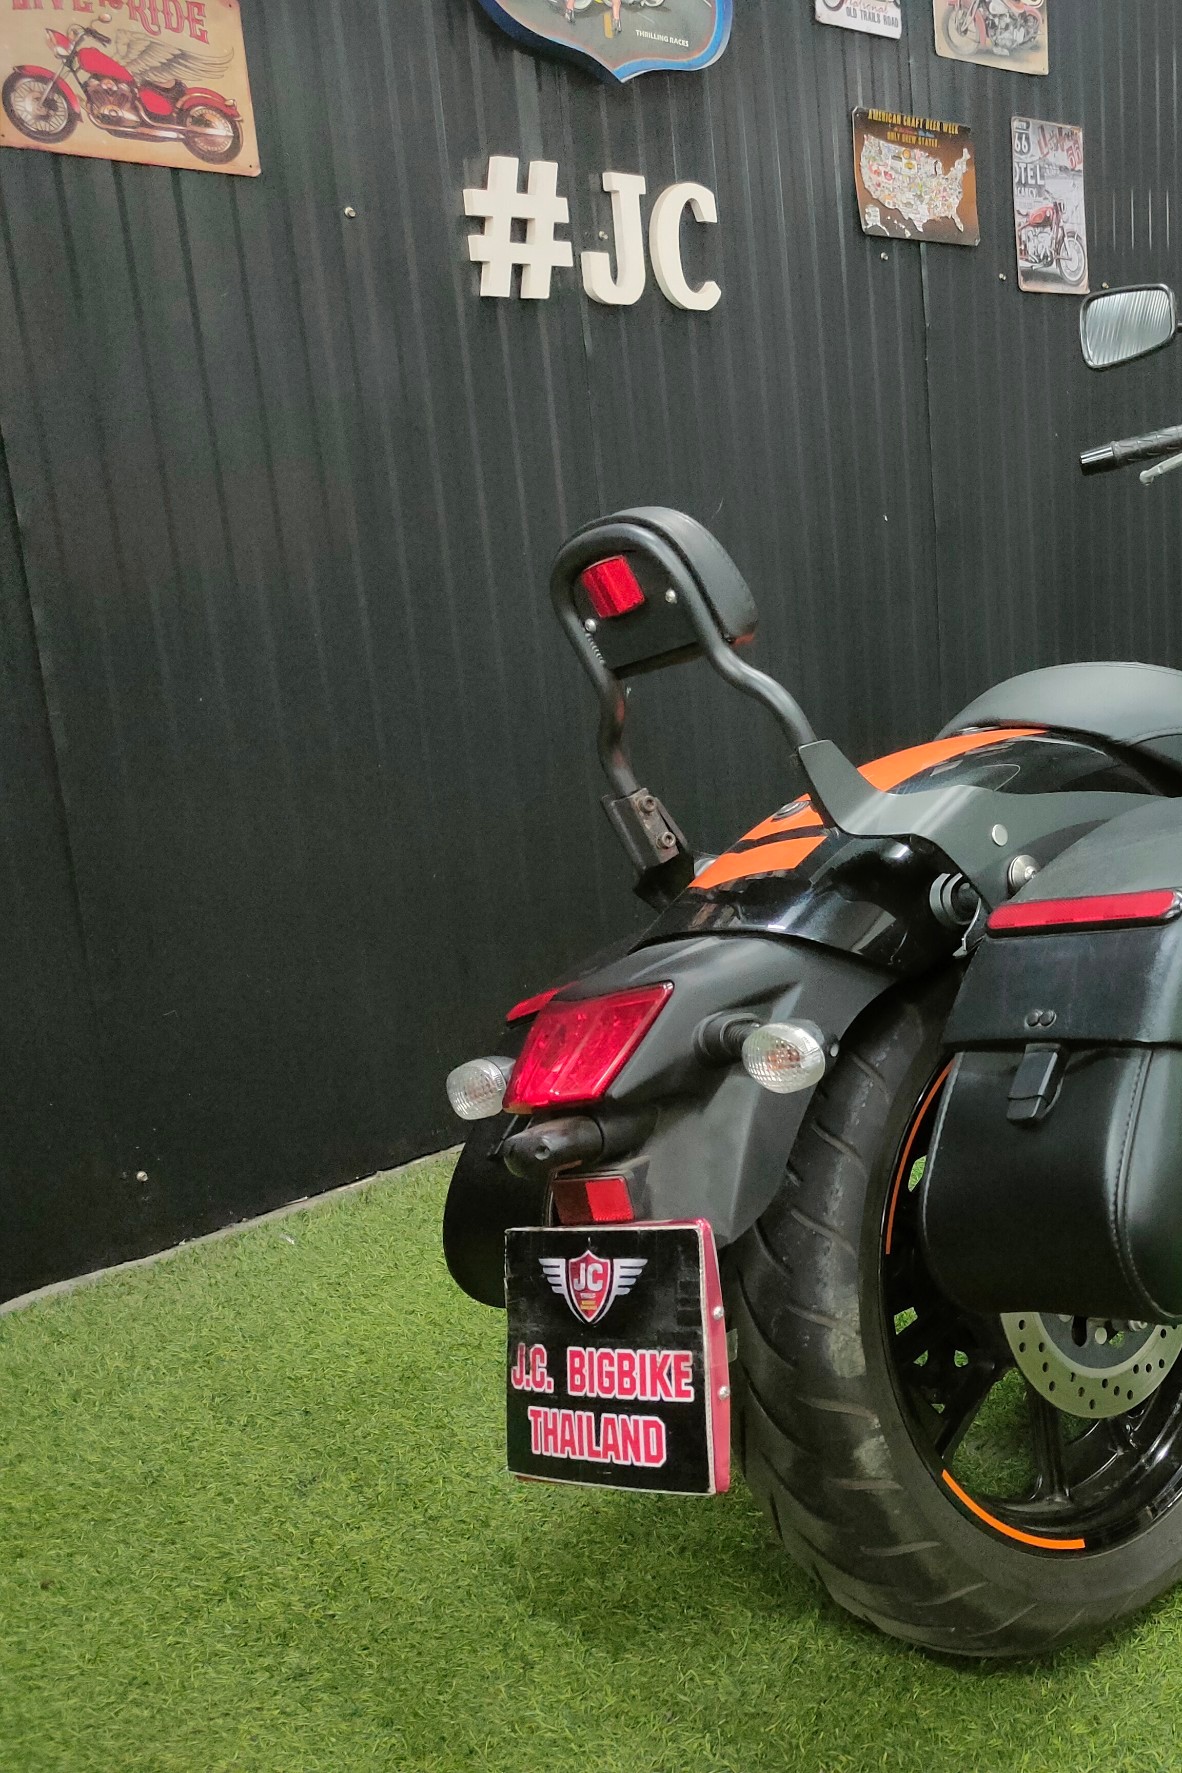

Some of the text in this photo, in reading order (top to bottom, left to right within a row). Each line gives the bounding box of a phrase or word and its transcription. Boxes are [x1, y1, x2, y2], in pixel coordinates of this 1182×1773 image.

[635, 29, 669, 43] THRILLING
[868, 109, 902, 124] AMERICAN
[573, 1262, 604, 1292] JC
[511, 1343, 694, 1402] J.C. BIGBIKE
[527, 1405, 667, 1468] THAILAND
